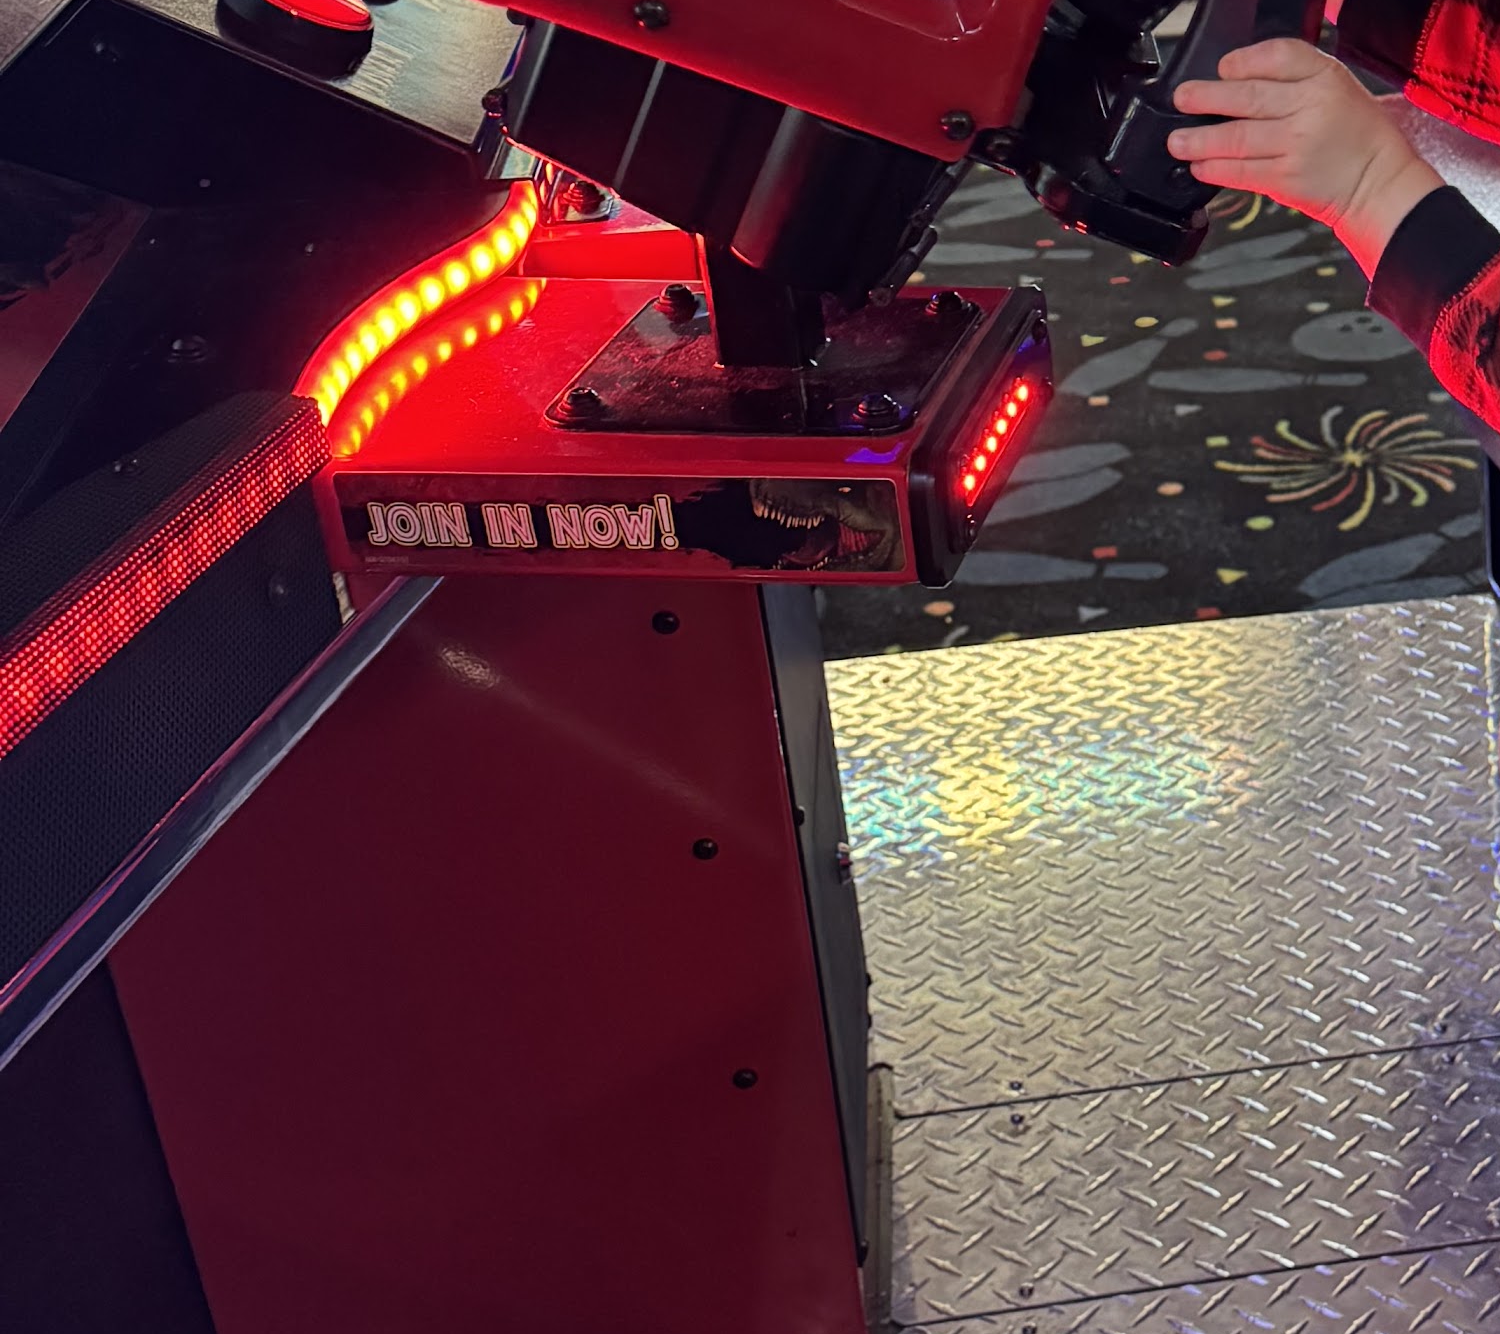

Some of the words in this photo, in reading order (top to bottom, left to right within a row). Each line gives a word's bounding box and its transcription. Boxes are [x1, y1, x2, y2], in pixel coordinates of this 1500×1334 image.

[367, 501, 473, 548] JOIN
[481, 503, 537, 549] IN
[546, 494, 680, 550] NOW!
